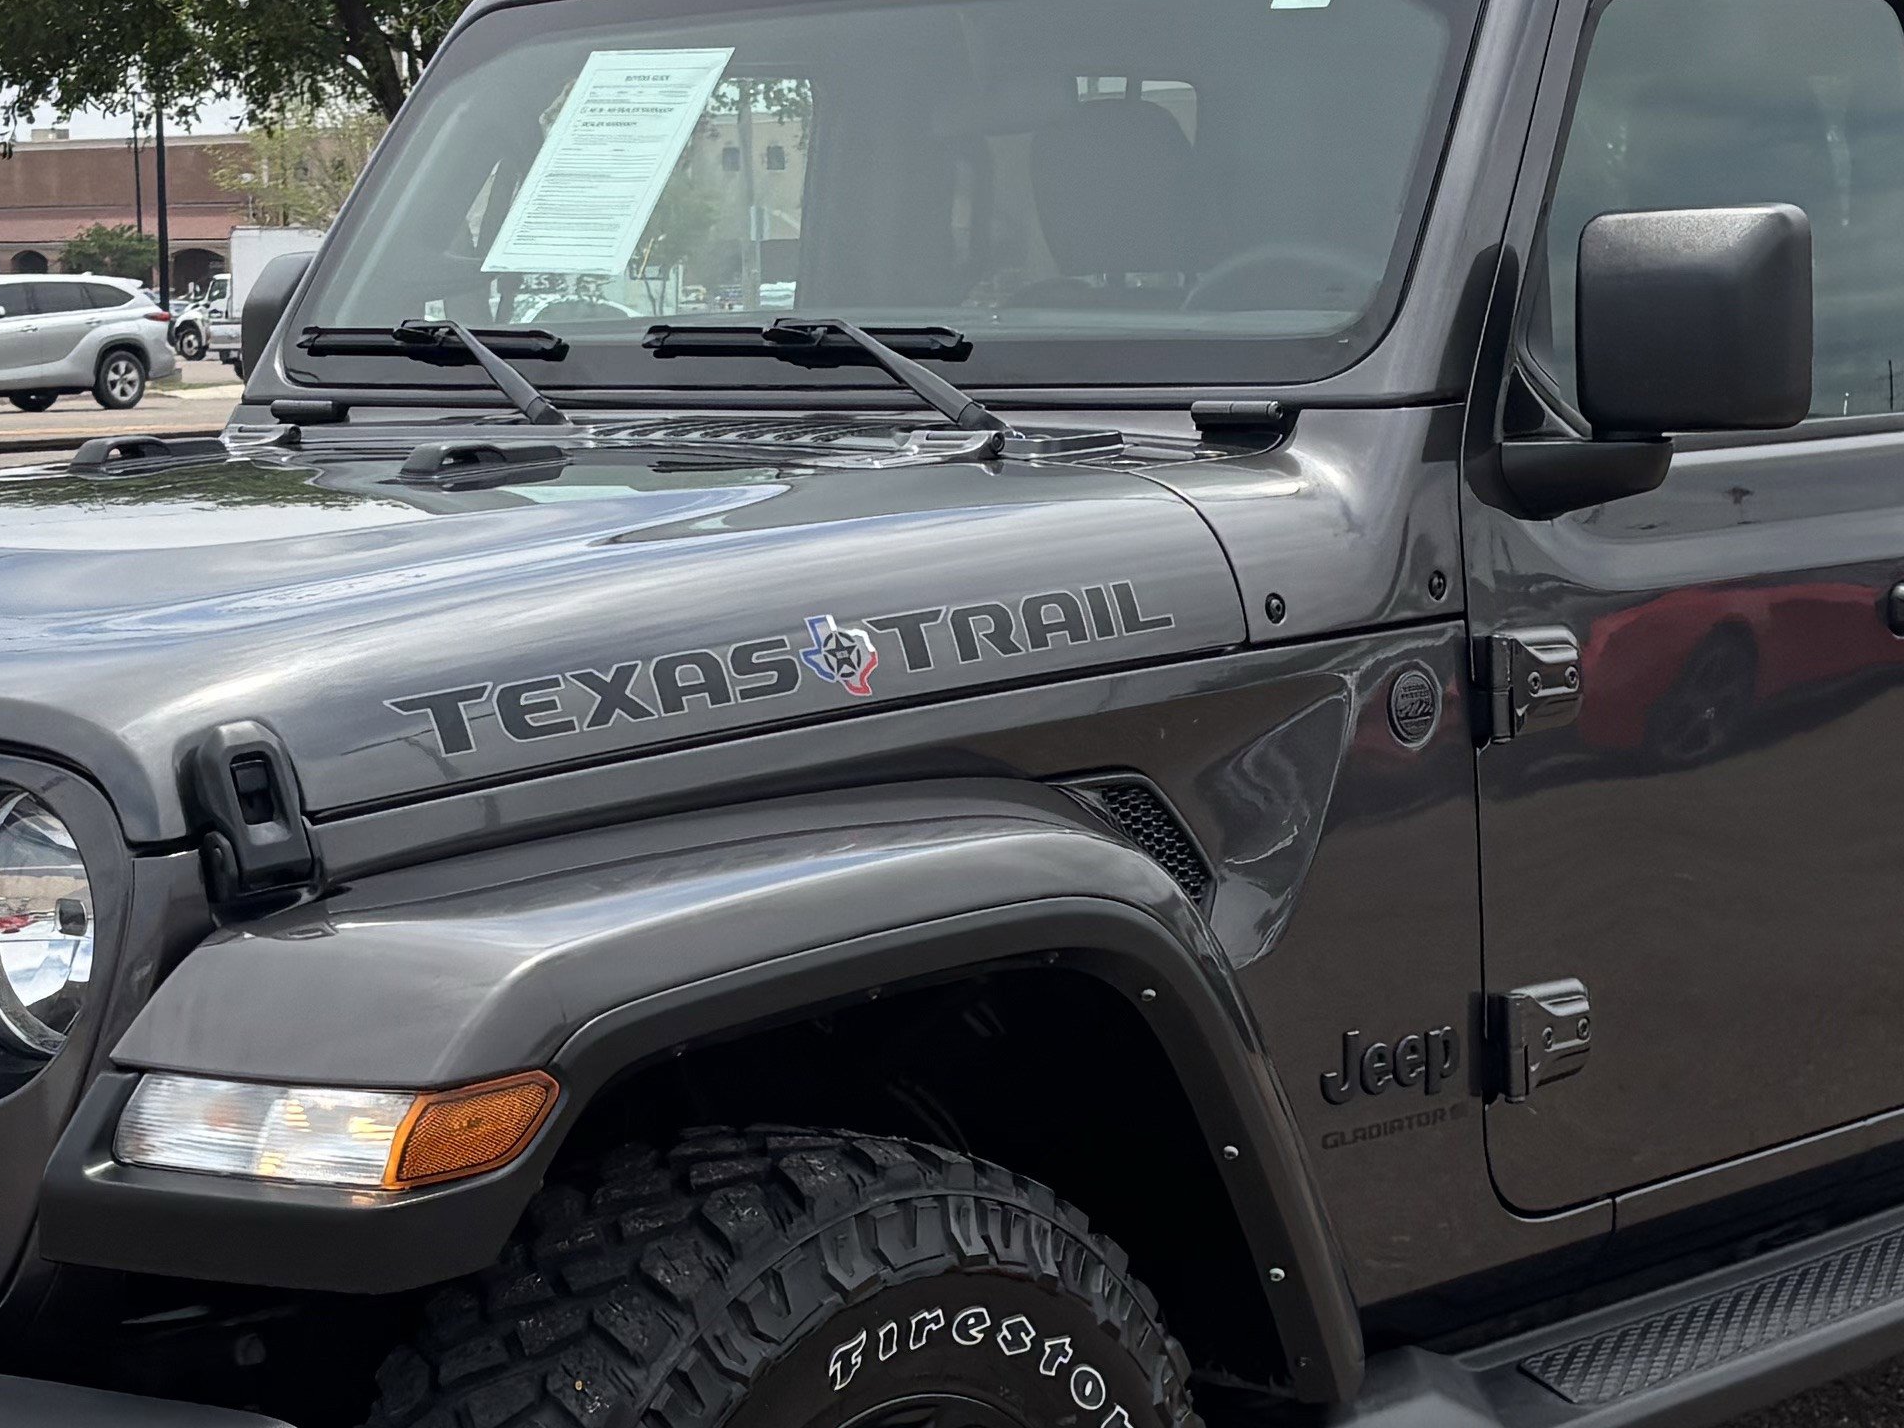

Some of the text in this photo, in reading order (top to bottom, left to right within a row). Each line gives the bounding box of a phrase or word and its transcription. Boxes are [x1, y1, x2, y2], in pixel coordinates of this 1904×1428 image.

[383, 579, 1177, 759] TEXAS TRAIL
[1319, 1025, 1461, 1106] Jeep
[1321, 1107, 1448, 1150] GLADIATOR
